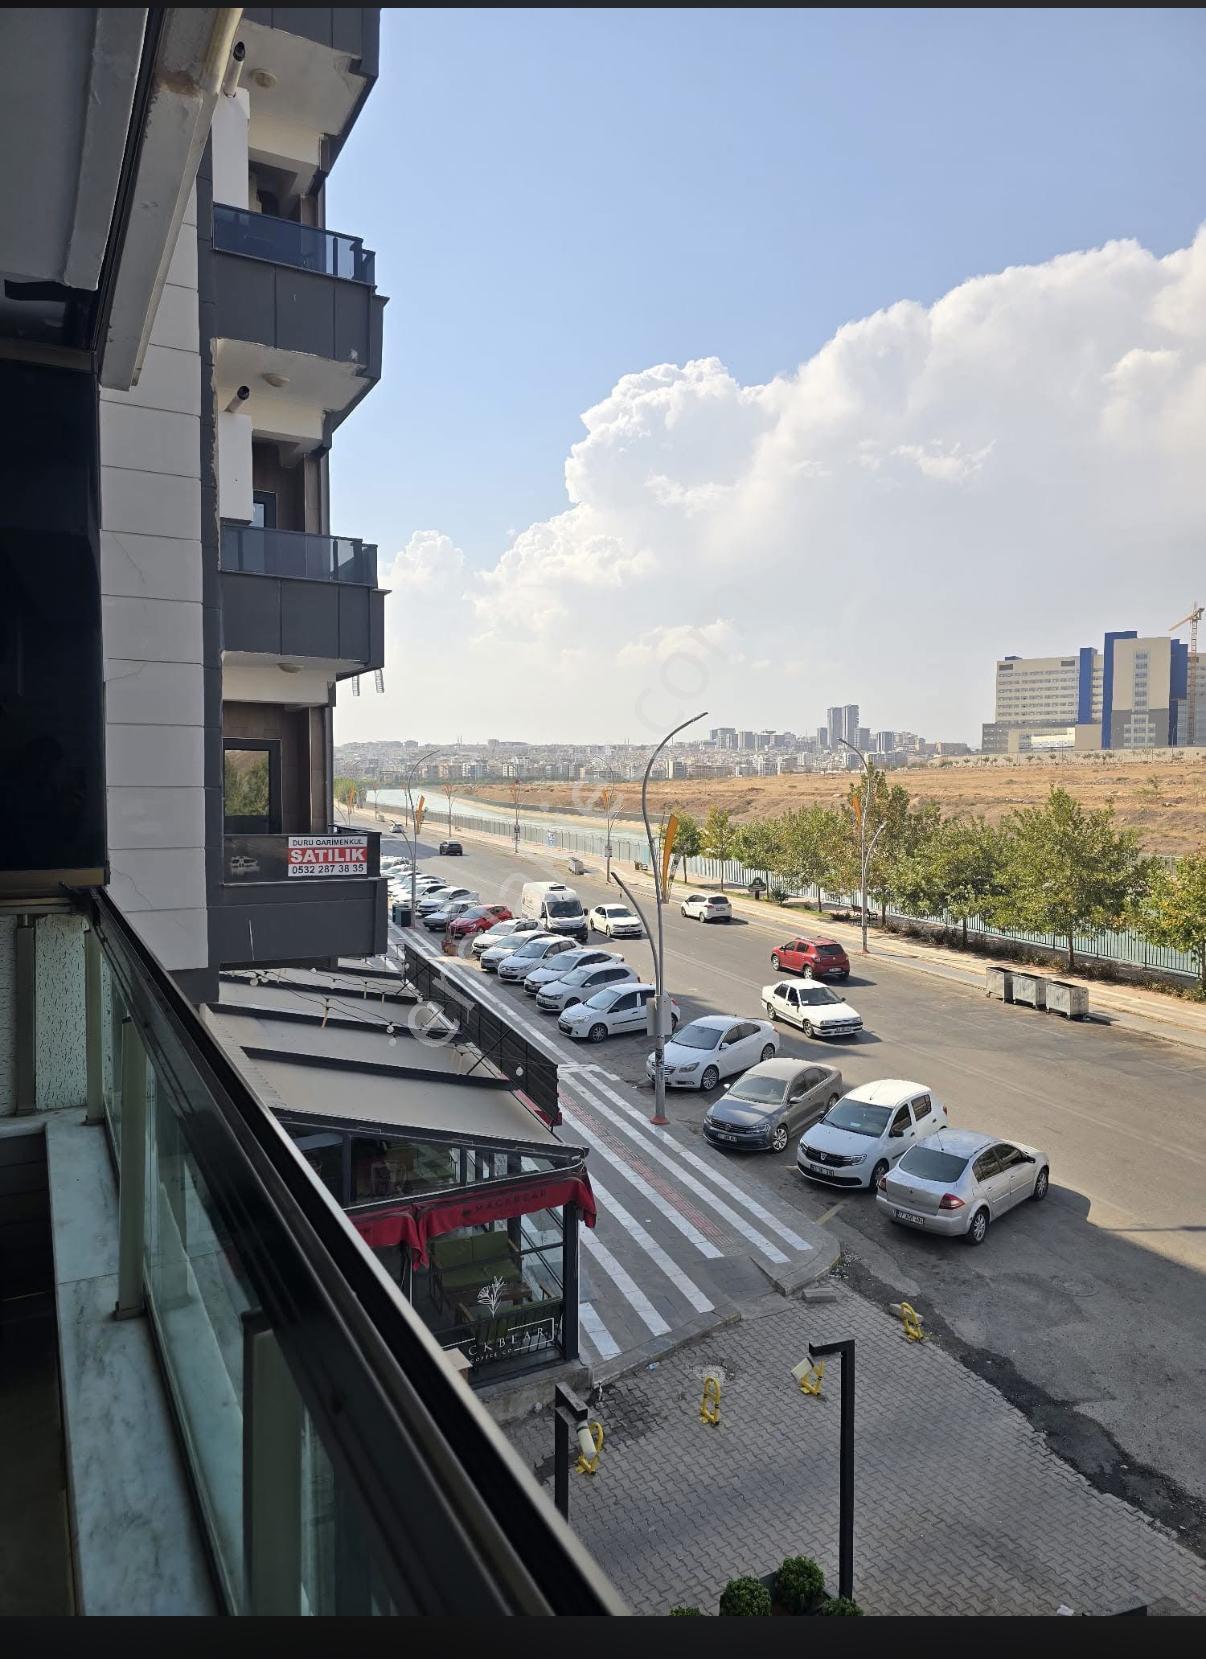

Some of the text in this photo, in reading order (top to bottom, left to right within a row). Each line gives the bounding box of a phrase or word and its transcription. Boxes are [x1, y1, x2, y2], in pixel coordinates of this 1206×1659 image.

[292, 839, 314, 847] DURU
[290, 848, 365, 863] SATILIK
[292, 863, 364, 874] 0532 287 38 35
[468, 1327, 547, 1355] CKBEAR
